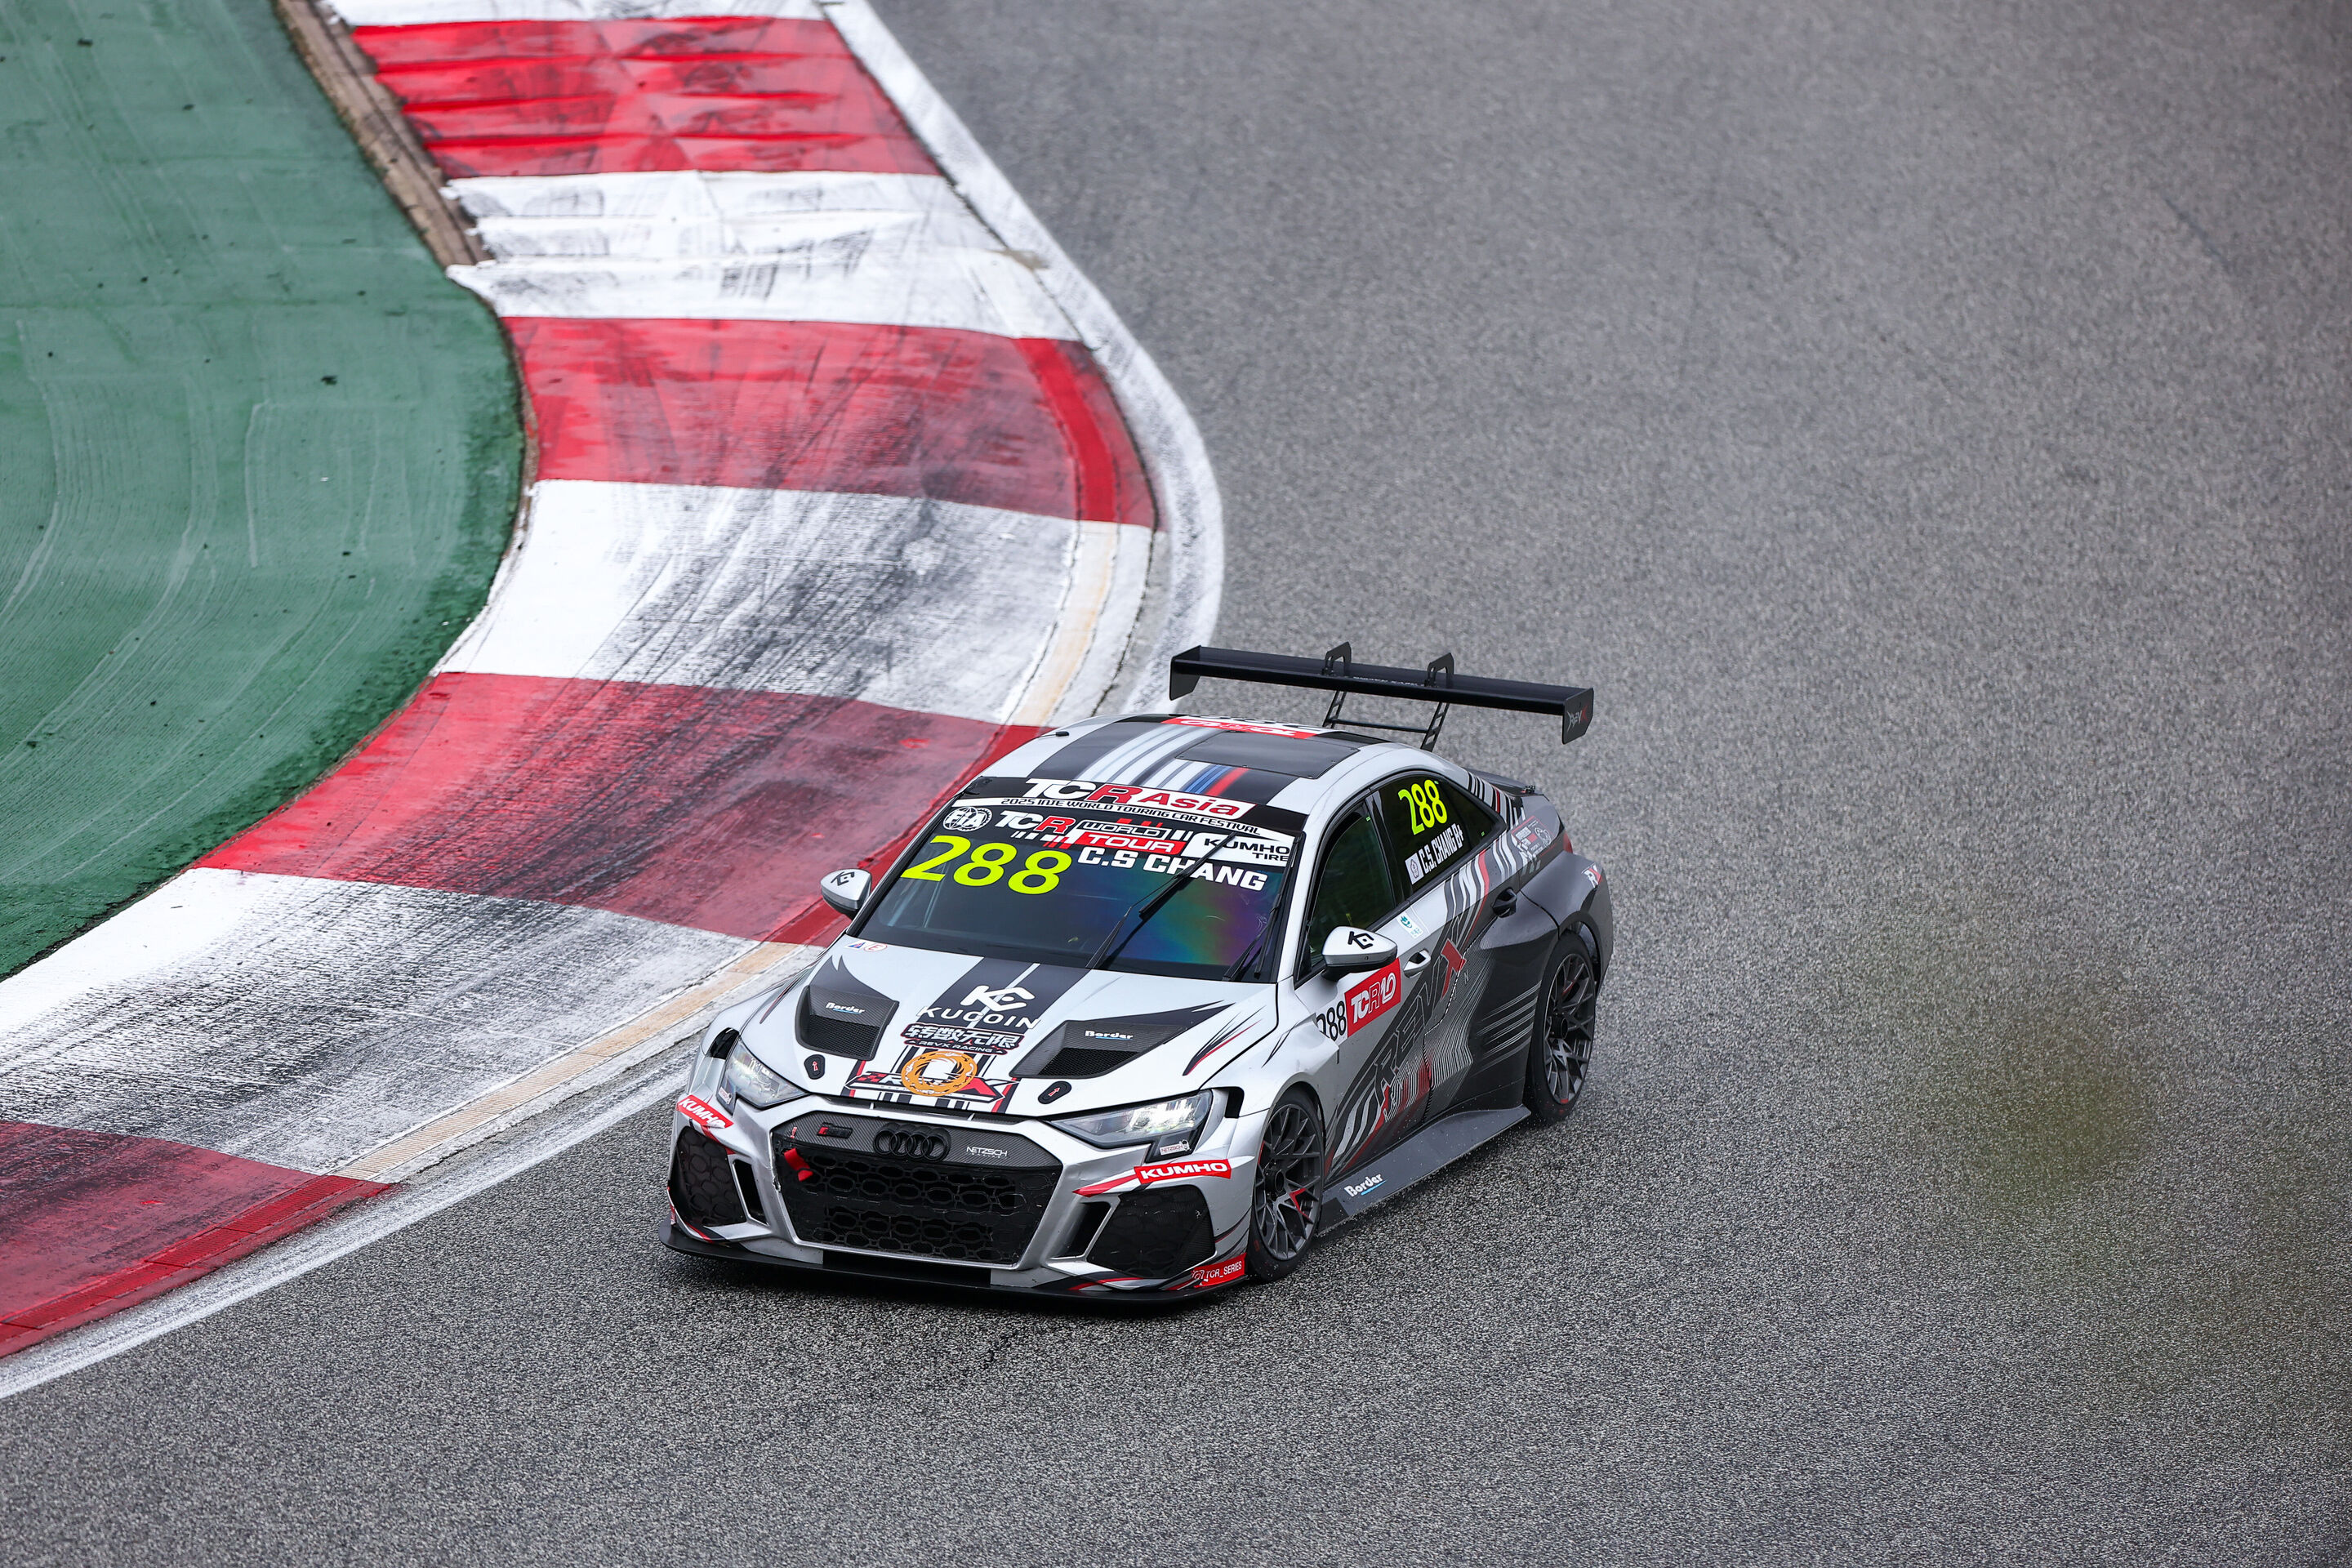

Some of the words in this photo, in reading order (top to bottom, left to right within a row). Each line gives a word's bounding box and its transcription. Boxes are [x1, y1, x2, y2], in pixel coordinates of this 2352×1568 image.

[1022, 778, 1143, 804] TCR
[1138, 792, 1241, 816] Asia
[1398, 779, 1447, 835] 288
[995, 810, 1076, 834] TCR
[1038, 799, 1063, 807] INJE
[1067, 800, 1112, 810] WORLD
[1113, 806, 1170, 817] TOURING
[1172, 812, 1198, 822] CAR
[1199, 817, 1260, 835] FESTIVAL
[1083, 822, 1160, 837] WORLD
[1088, 833, 1175, 853] TOUR
[1204, 838, 1290, 855] KUMHO
[1431, 826, 1458, 865] CHANG
[900, 835, 1072, 895] 288
[1252, 852, 1290, 862] TIRE
[1077, 846, 1138, 870] C.S
[1143, 853, 1268, 891] CHANG
[826, 1002, 865, 1013] Border
[915, 1006, 1041, 1031] KUCOIN
[1085, 1030, 1134, 1040] Border
[952, 1045, 993, 1054] RACING
[679, 1098, 726, 1128] KUMHO
[966, 1146, 1008, 1156] NETZSCH
[1141, 1160, 1227, 1180] KUMHO
[1343, 1174, 1383, 1197] Border
[1205, 1260, 1242, 1280] TCR_SERIES
